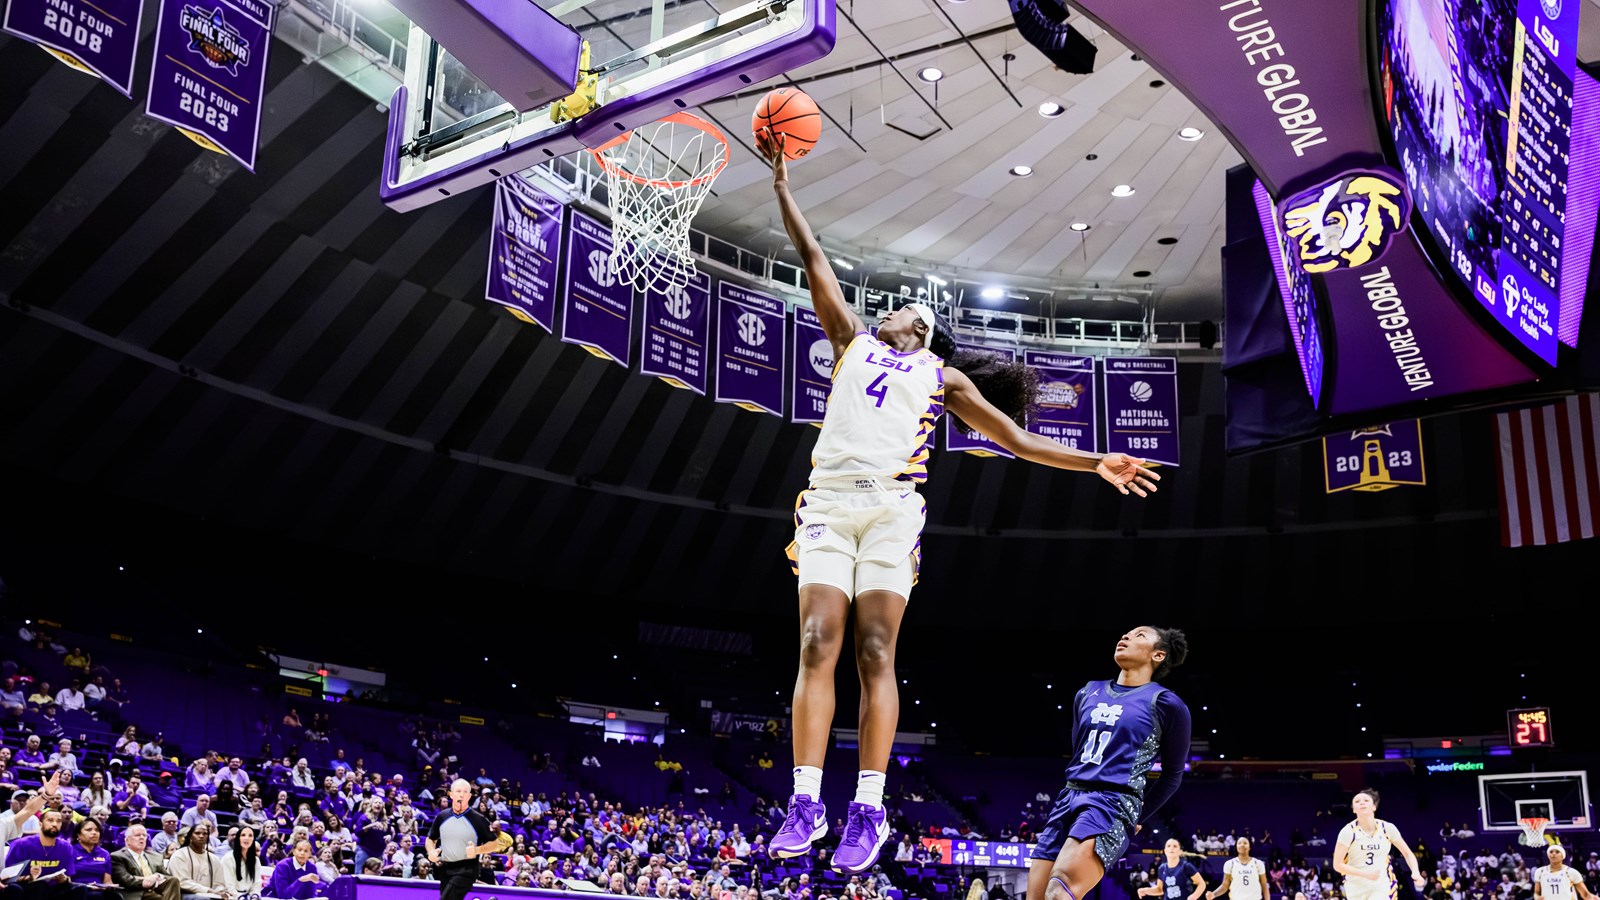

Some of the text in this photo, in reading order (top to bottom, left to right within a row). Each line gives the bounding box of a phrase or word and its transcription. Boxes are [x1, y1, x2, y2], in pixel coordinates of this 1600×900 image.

[44, 8, 102, 54] 2008
[80, 10, 114, 38] FOUR
[182, 14, 215, 40] FINAL
[217, 32, 247, 62] FOUR
[1534, 16, 1560, 58] LSU
[174, 72, 239, 117] FINAL FOUR
[180, 92, 228, 132] 2023
[1256, 64, 1328, 157] GLOBAL
[507, 218, 547, 254] BROWN
[515, 212, 541, 238] DALE
[588, 250, 616, 288] SEC
[664, 284, 692, 320] SEC
[1477, 275, 1496, 305] LSU
[660, 318, 694, 337] CHAMPIONS
[737, 312, 766, 346] SEC
[1360, 266, 1434, 392] VENTURE GLOBAL
[734, 346, 769, 361] CHAMPIONS
[865, 352, 913, 373] LSU
[806, 387, 826, 400] FINAL
[866, 372, 888, 408] 4
[1116, 418, 1169, 426] CHAMPIONS
[1121, 410, 1164, 418] NATIONAL
[1039, 426, 1082, 437] FINAL FOUR
[1128, 437, 1158, 449] 1935
[1336, 450, 1412, 472] 20 23
[1518, 711, 1546, 724] 4:45
[1516, 724, 1545, 744] 27
[1080, 730, 1112, 765] 11
[955, 852, 969, 864] 41
[979, 845, 1019, 856] 2 4:45
[1365, 852, 1374, 865] 3
[1243, 876, 1249, 886] 6
[1551, 884, 1559, 894] 11
